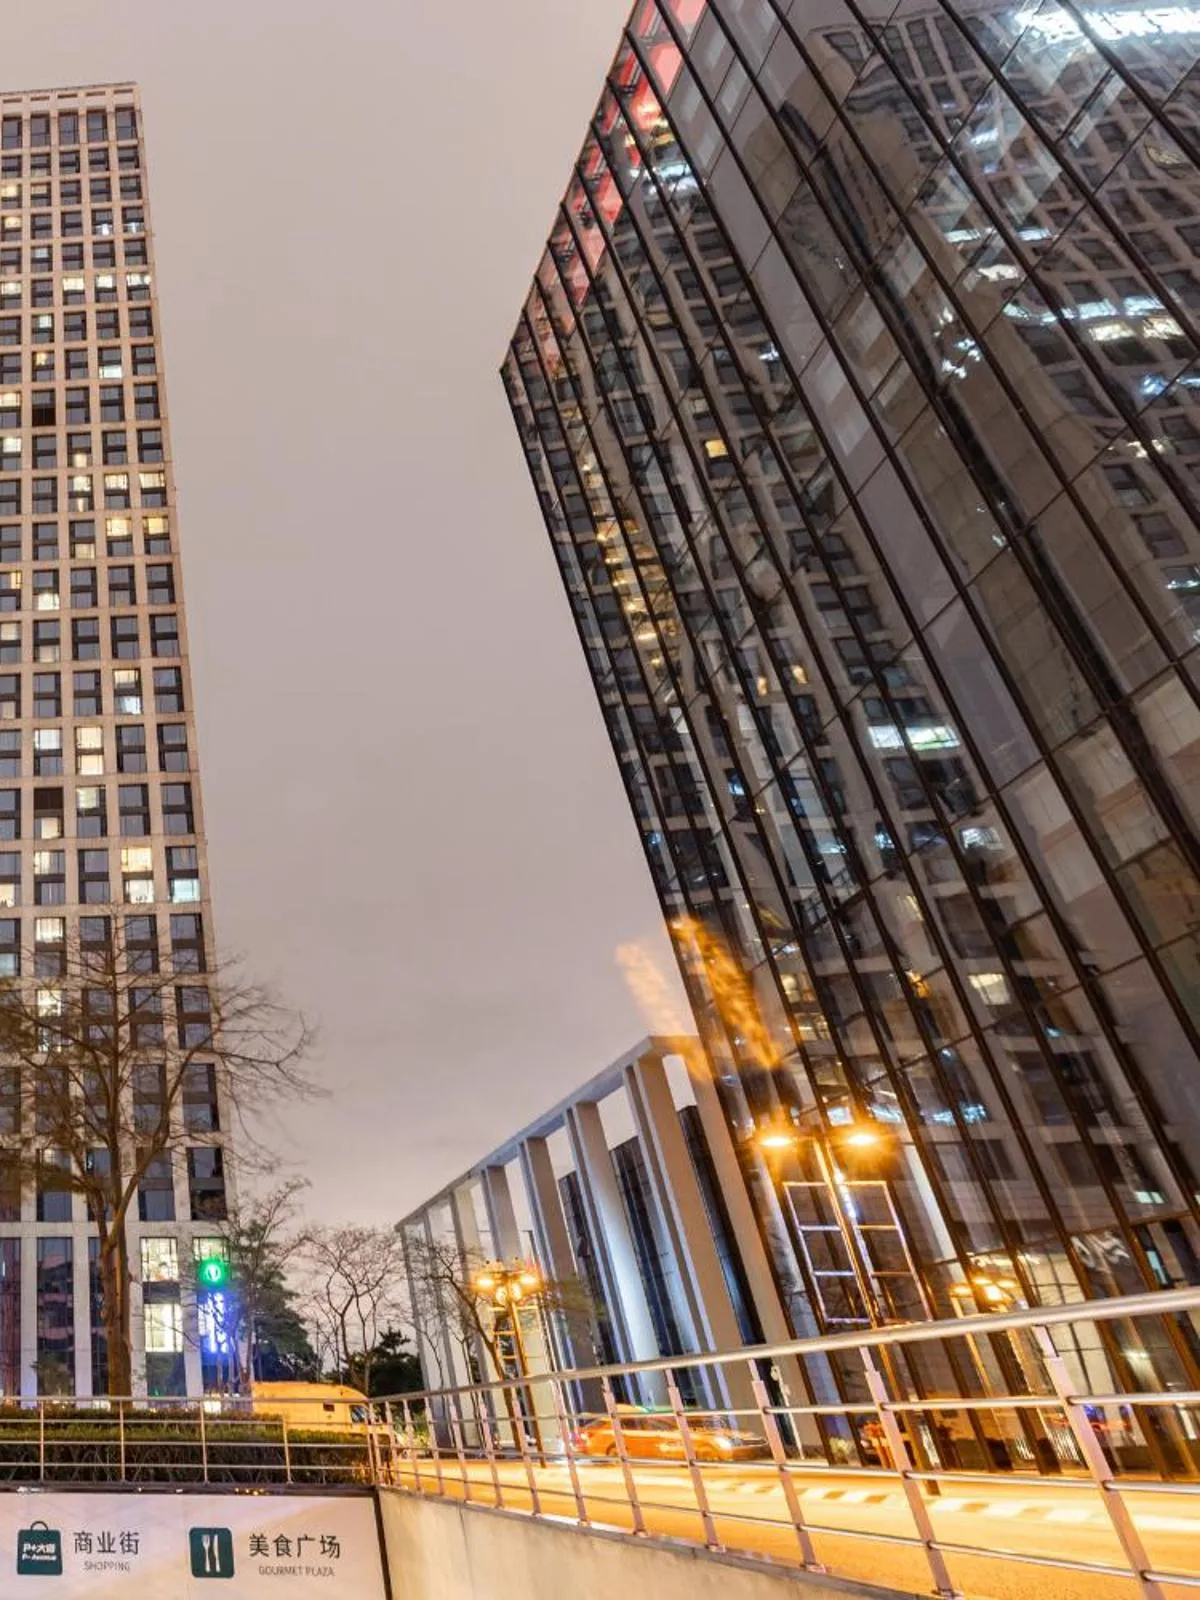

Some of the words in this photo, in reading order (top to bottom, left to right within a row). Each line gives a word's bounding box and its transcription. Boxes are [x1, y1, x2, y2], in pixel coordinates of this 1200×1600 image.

[72, 1530, 140, 1555] 商业街
[248, 1533, 341, 1559] 美食广场
[83, 1560, 131, 1572] SHOPPING
[258, 1565, 303, 1577] GOURMET
[305, 1566, 336, 1578] PLAZA
